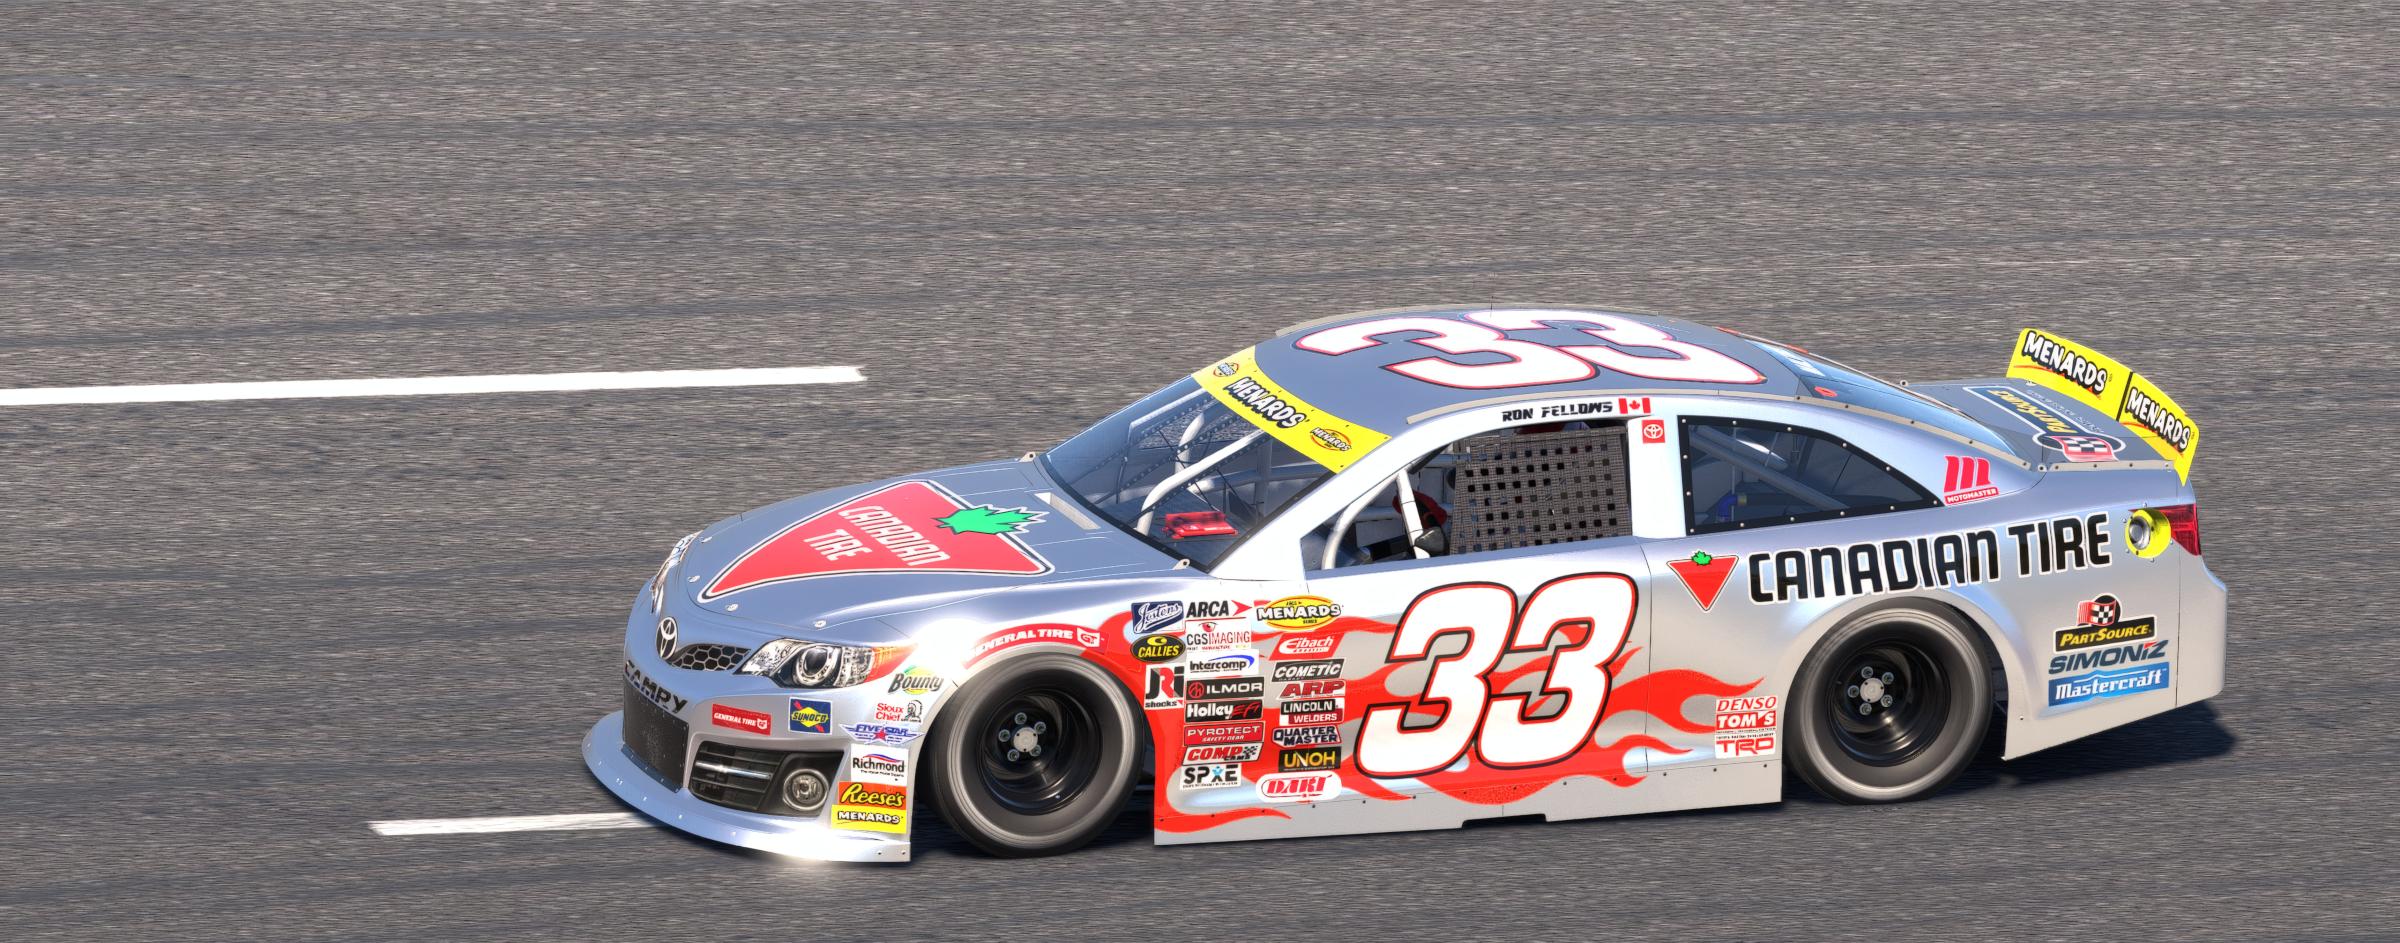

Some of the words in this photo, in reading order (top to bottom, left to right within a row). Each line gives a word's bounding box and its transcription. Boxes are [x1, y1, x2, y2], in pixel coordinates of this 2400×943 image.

[1291, 309, 1767, 389] 33
[2022, 330, 2108, 393] MENARDS
[1223, 376, 1306, 428] MENARDS
[1501, 408, 1534, 422] RON
[1541, 401, 1613, 418] FELLOWS
[2125, 388, 2191, 453] MENARDS
[1947, 488, 1997, 504] MOTOMASTER
[804, 528, 872, 562] TIRE
[1749, 529, 1999, 602] CANADIAN
[2007, 513, 2111, 576] TIRE
[1133, 602, 1183, 633] Jostens
[1186, 600, 1229, 618] ARCA
[1256, 603, 1342, 622] MENARDS
[976, 629, 1036, 653] NERAL
[1038, 628, 1074, 639] TIRE
[1278, 636, 1334, 654] Eibach
[1137, 644, 1180, 658] CALLIES
[1190, 660, 1247, 671] Intercomp
[888, 673, 944, 694] Bounty
[1353, 571, 1639, 779] 33
[1206, 682, 1263, 694] ILMOR
[1280, 681, 1344, 698] ARP
[2055, 669, 2161, 700] Mastercraft
[877, 702, 904, 713] Sioux
[1145, 700, 1178, 708] shocks
[1283, 700, 1333, 713] LINCOLN
[1717, 696, 1777, 711] DENSO
[714, 712, 741, 724] GENERAL
[742, 718, 757, 726] TIRE
[792, 711, 828, 723] SUNOCO
[875, 711, 901, 721] Chief
[1293, 713, 1338, 723] WELDERS
[855, 724, 882, 733] FIVE
[884, 726, 909, 737] STAR
[1187, 725, 1261, 737] PYROTECT
[1273, 726, 1335, 741] QUARTER
[1283, 734, 1338, 746] MASTER
[1716, 737, 1774, 756] TRD
[1187, 746, 1243, 761] COMP
[1284, 751, 1336, 768] UNOH
[852, 757, 905, 773] Richmond
[1267, 776, 1328, 794] DART
[841, 783, 905, 807] Reese's
[837, 810, 900, 825] MENARDS
